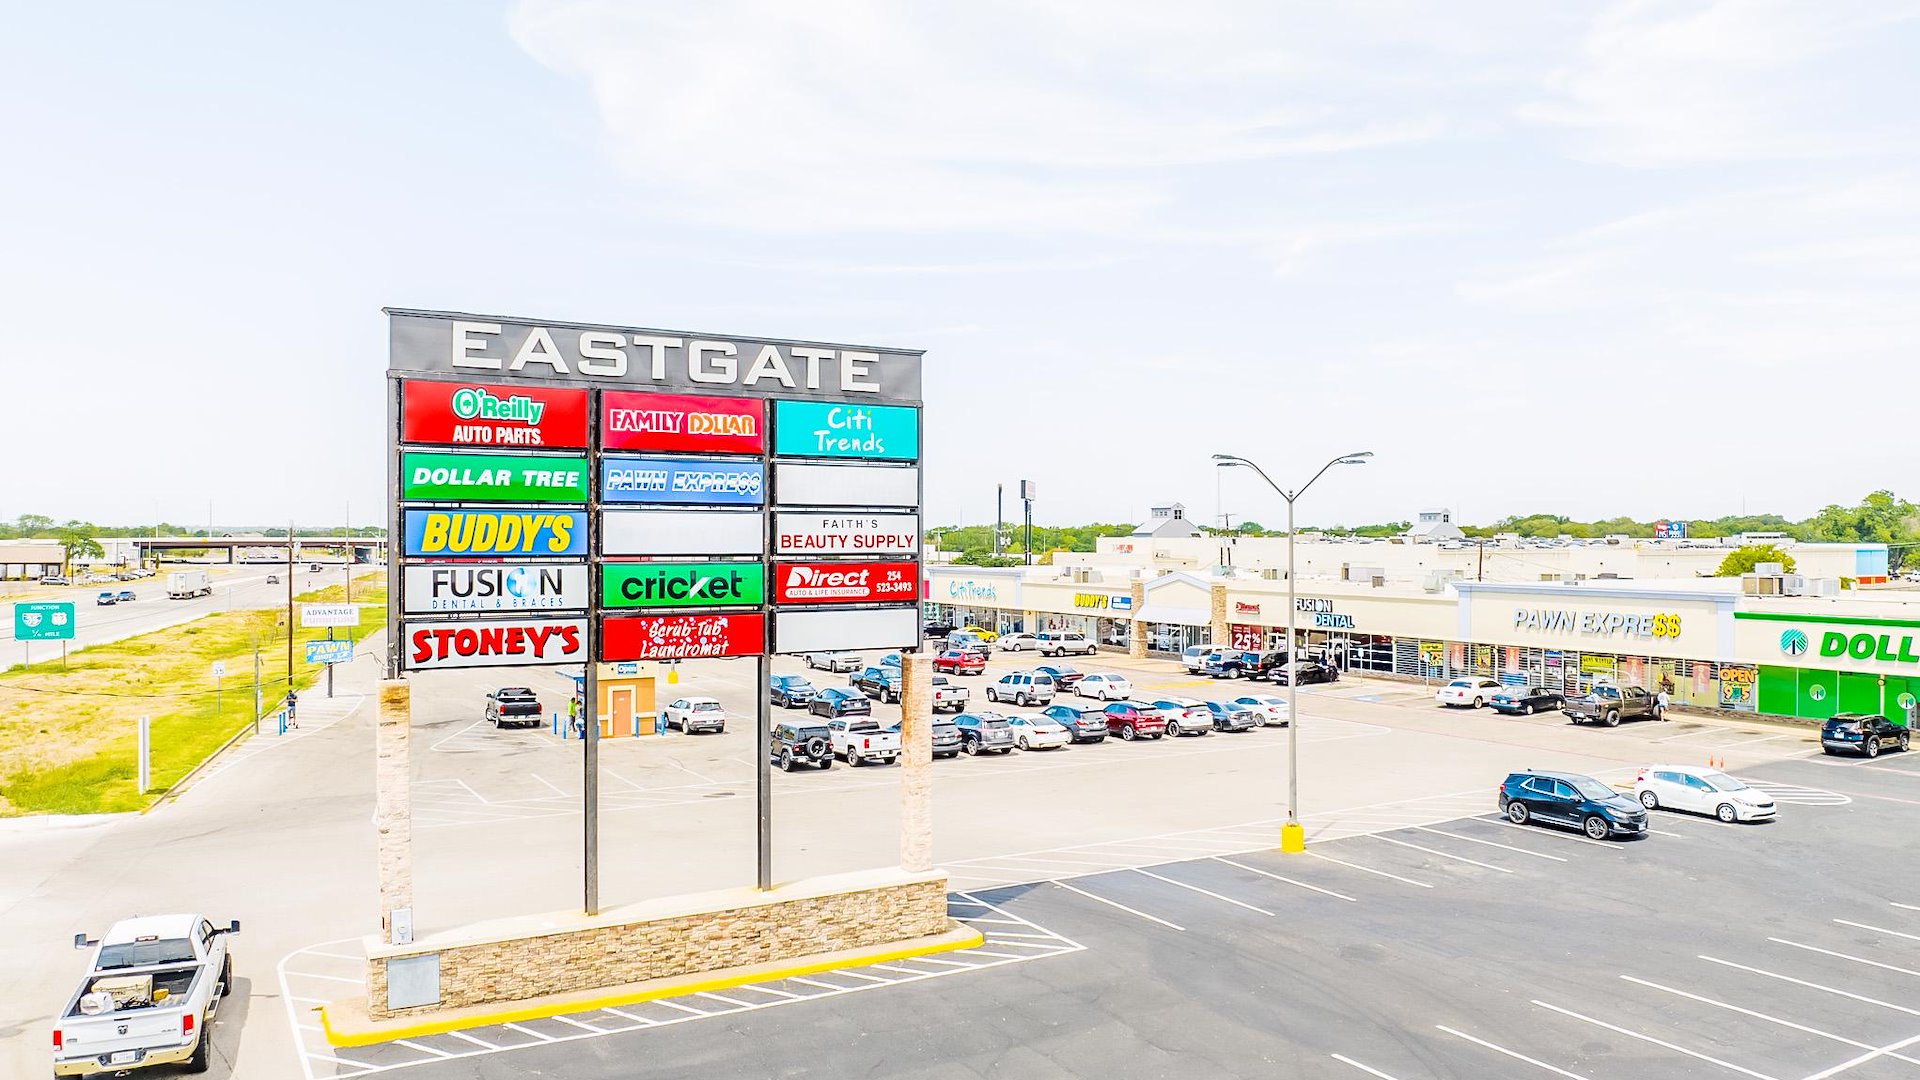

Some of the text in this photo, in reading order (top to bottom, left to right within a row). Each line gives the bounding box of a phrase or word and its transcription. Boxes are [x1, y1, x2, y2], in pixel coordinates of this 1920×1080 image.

[451, 320, 881, 393] EASTGATE
[452, 387, 546, 426] O'Reilly
[609, 408, 757, 436] FAMILY DOLLAR
[827, 407, 872, 430] Citi
[453, 425, 542, 444] AUTO PARTS
[813, 429, 886, 453] Trends
[412, 467, 579, 487] DOLLAR TREE
[606, 469, 668, 491] PAWN
[420, 513, 573, 553] BUDDY'S
[822, 519, 878, 529] FAITH'S
[780, 534, 914, 549] BEAUTY SUPPLY
[620, 570, 743, 600] cricket
[785, 566, 870, 587] Direct
[886, 571, 901, 581] 254
[789, 589, 807, 597] AUTO
[830, 588, 867, 596] INSURANCE
[876, 582, 912, 593] 523-3493
[432, 597, 564, 609] DENTAL & BRACES
[1074, 593, 1108, 609] BUDDY'S
[648, 618, 722, 638] Scrub-Tub
[1314, 614, 1355, 628] DENTAL
[1513, 608, 1681, 640] PAWN EXPRE$$
[307, 642, 350, 656] PAWN
[412, 625, 580, 664] STONEY'S
[640, 639, 730, 659] Laundromat
[1820, 631, 1919, 663] DOLL
[1720, 668, 1755, 683] OPEN
